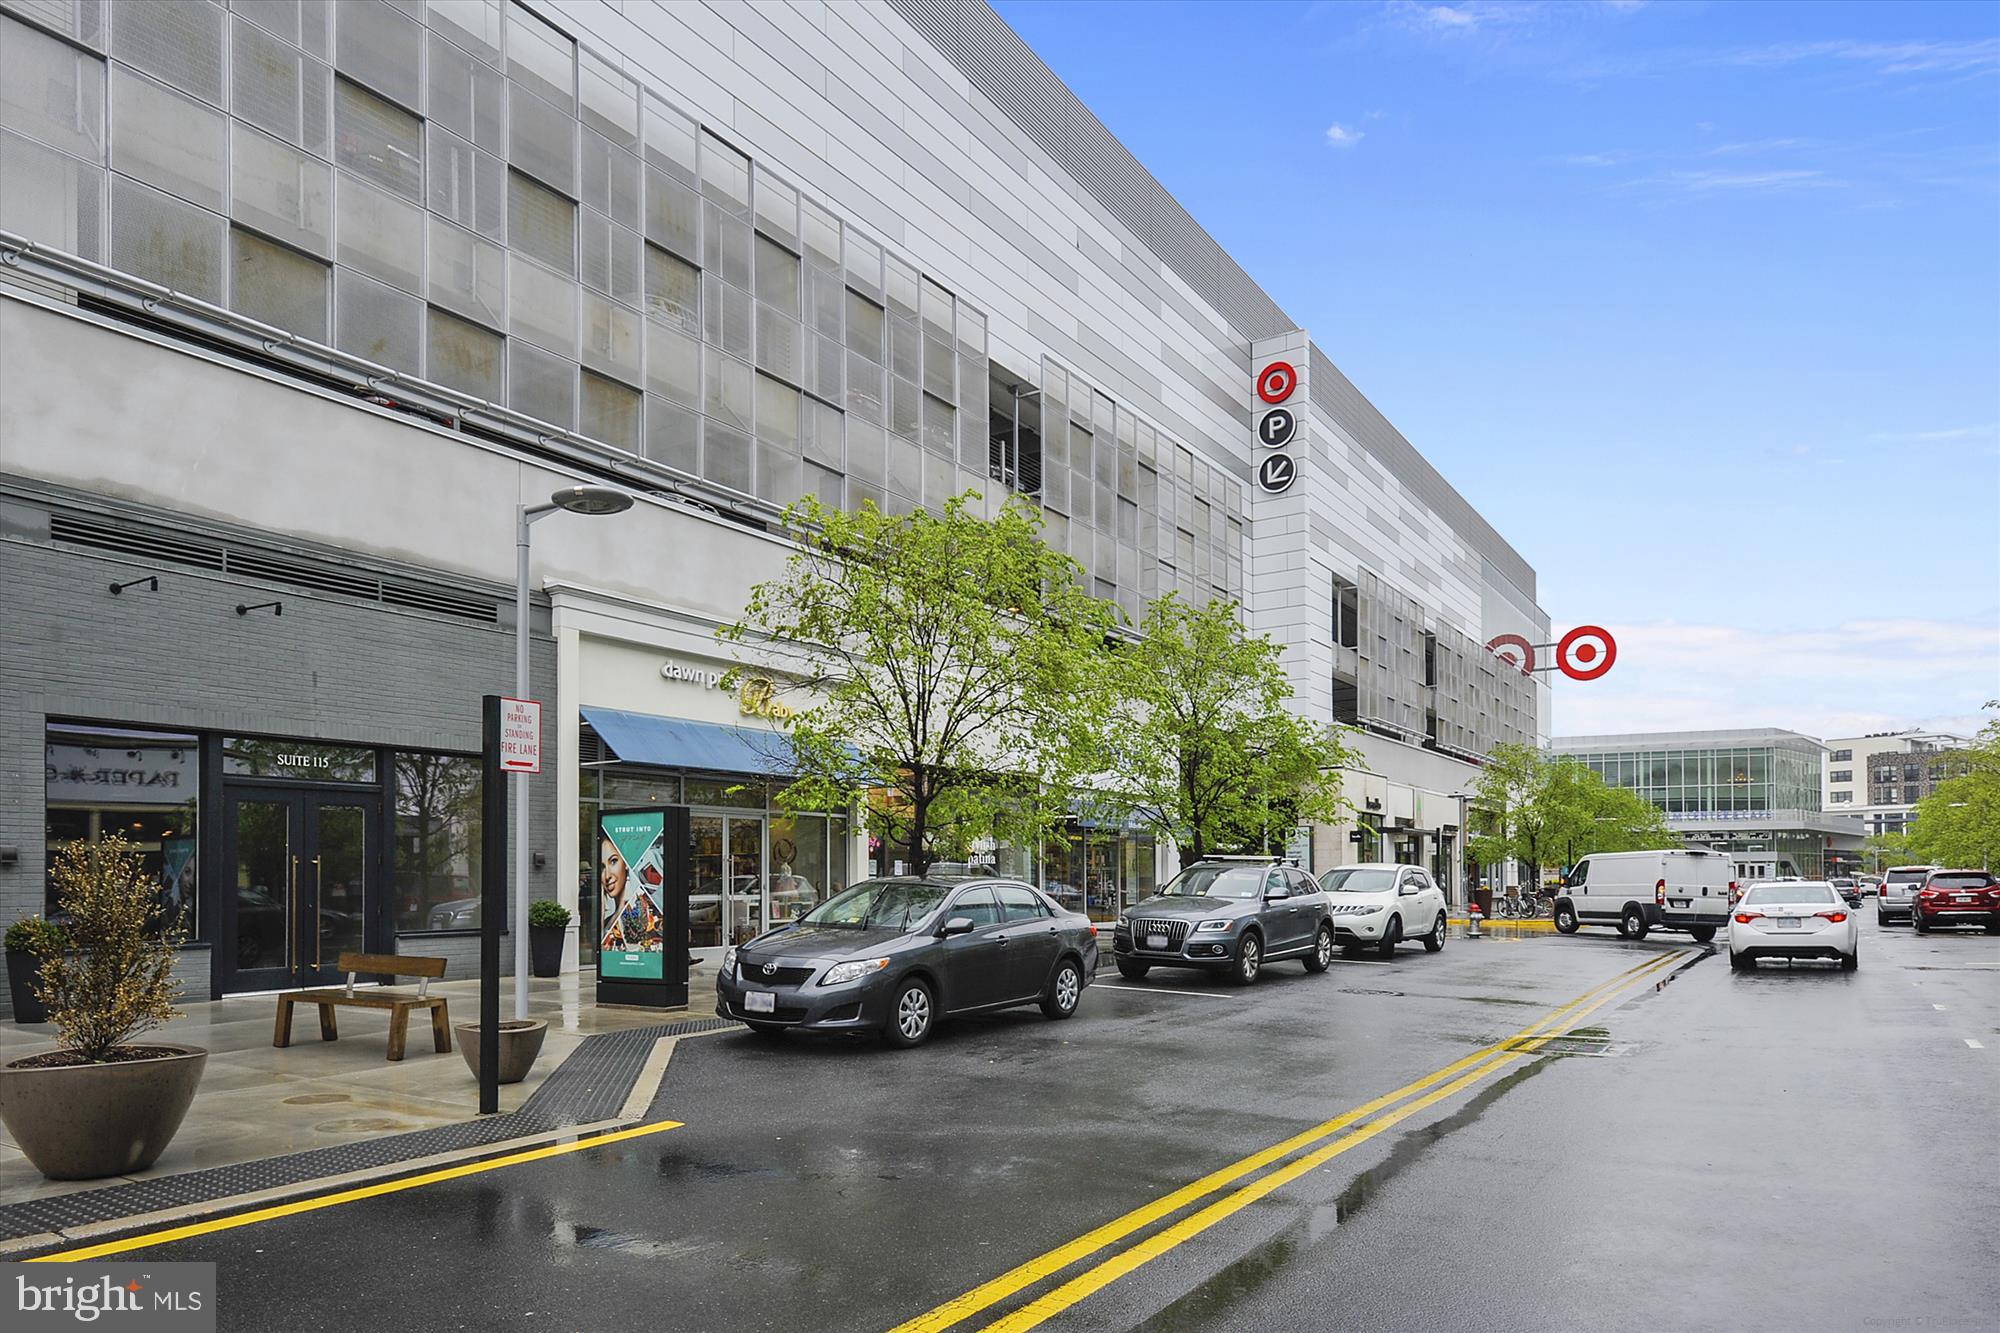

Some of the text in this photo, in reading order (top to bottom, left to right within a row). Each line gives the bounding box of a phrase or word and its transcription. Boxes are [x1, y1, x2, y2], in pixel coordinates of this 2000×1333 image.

[1269, 416, 1286, 439] P
[663, 659, 704, 683] dawn
[515, 704, 524, 714] NO
[507, 712, 532, 724] PARKING
[505, 728, 534, 740] STANDING
[501, 741, 537, 756] FIRE LANE
[277, 753, 329, 769] SUITE 115
[967, 853, 996, 869] patina
